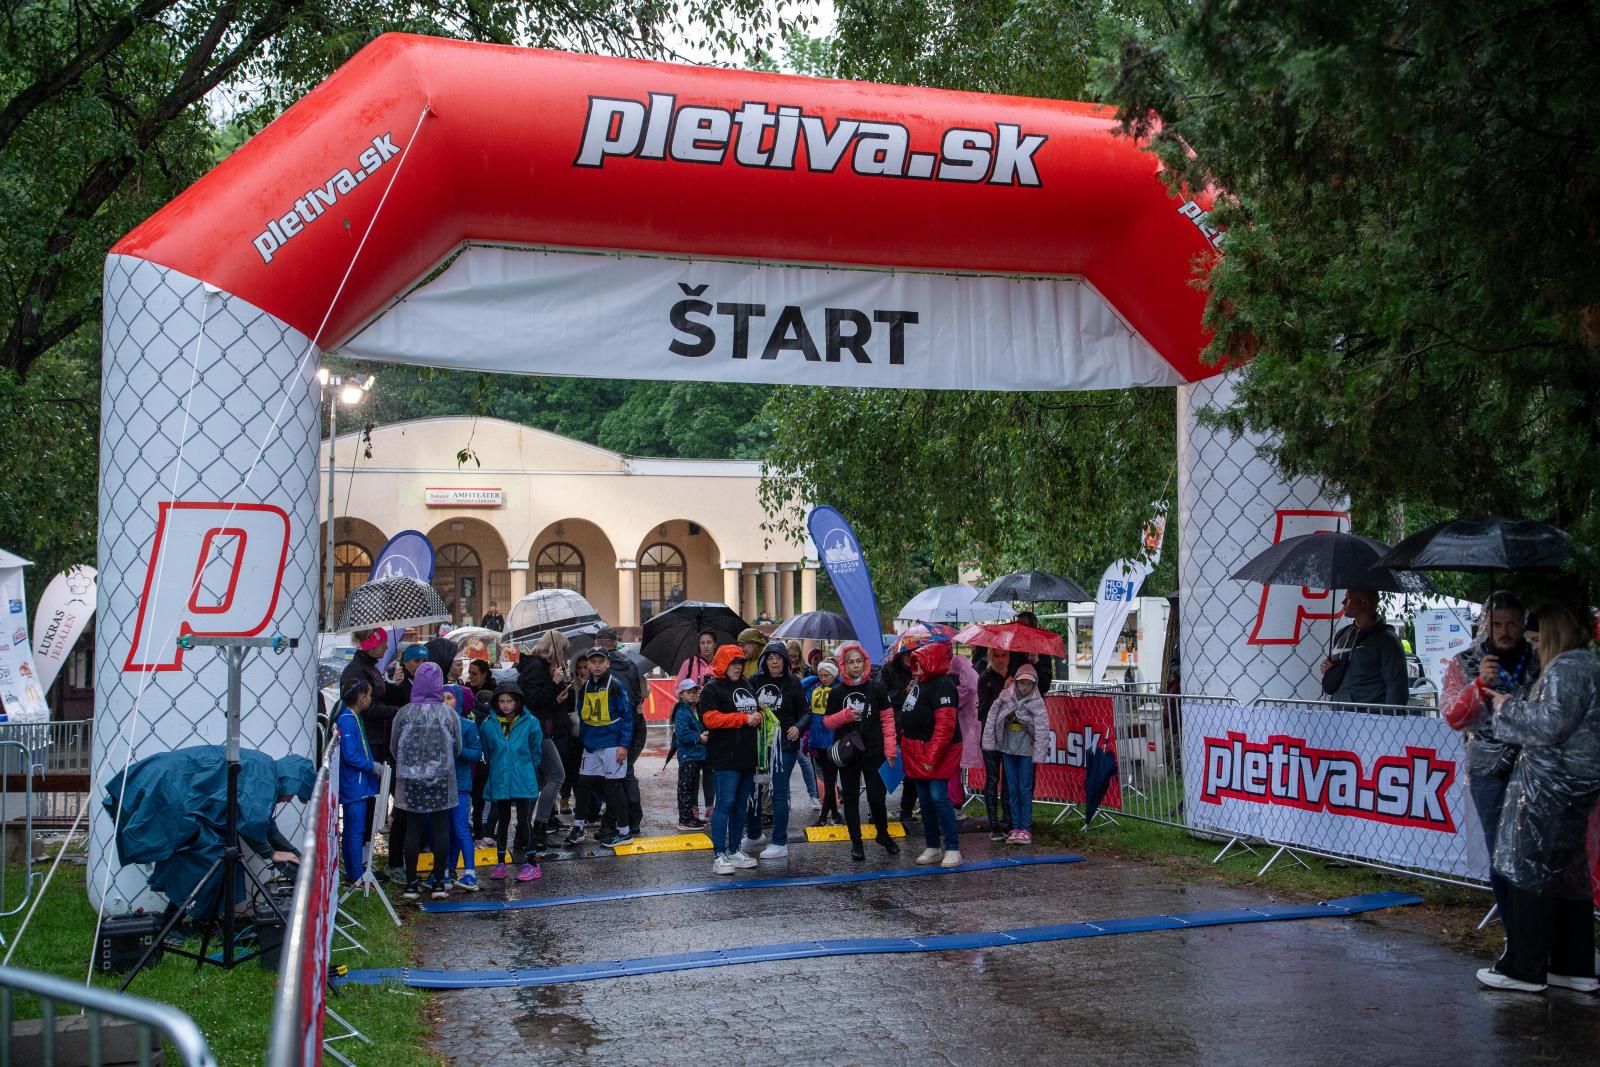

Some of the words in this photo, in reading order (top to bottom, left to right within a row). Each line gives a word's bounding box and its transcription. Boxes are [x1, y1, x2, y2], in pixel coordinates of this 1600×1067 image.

[572, 91, 1048, 188] pletiva.sk
[251, 131, 402, 265] pletiva.sk
[668, 282, 919, 365] ŠTART
[1106, 586, 1118, 594] HO
[38, 609, 65, 656] LUKRAS
[1206, 740, 1448, 823] pletiva.sk
